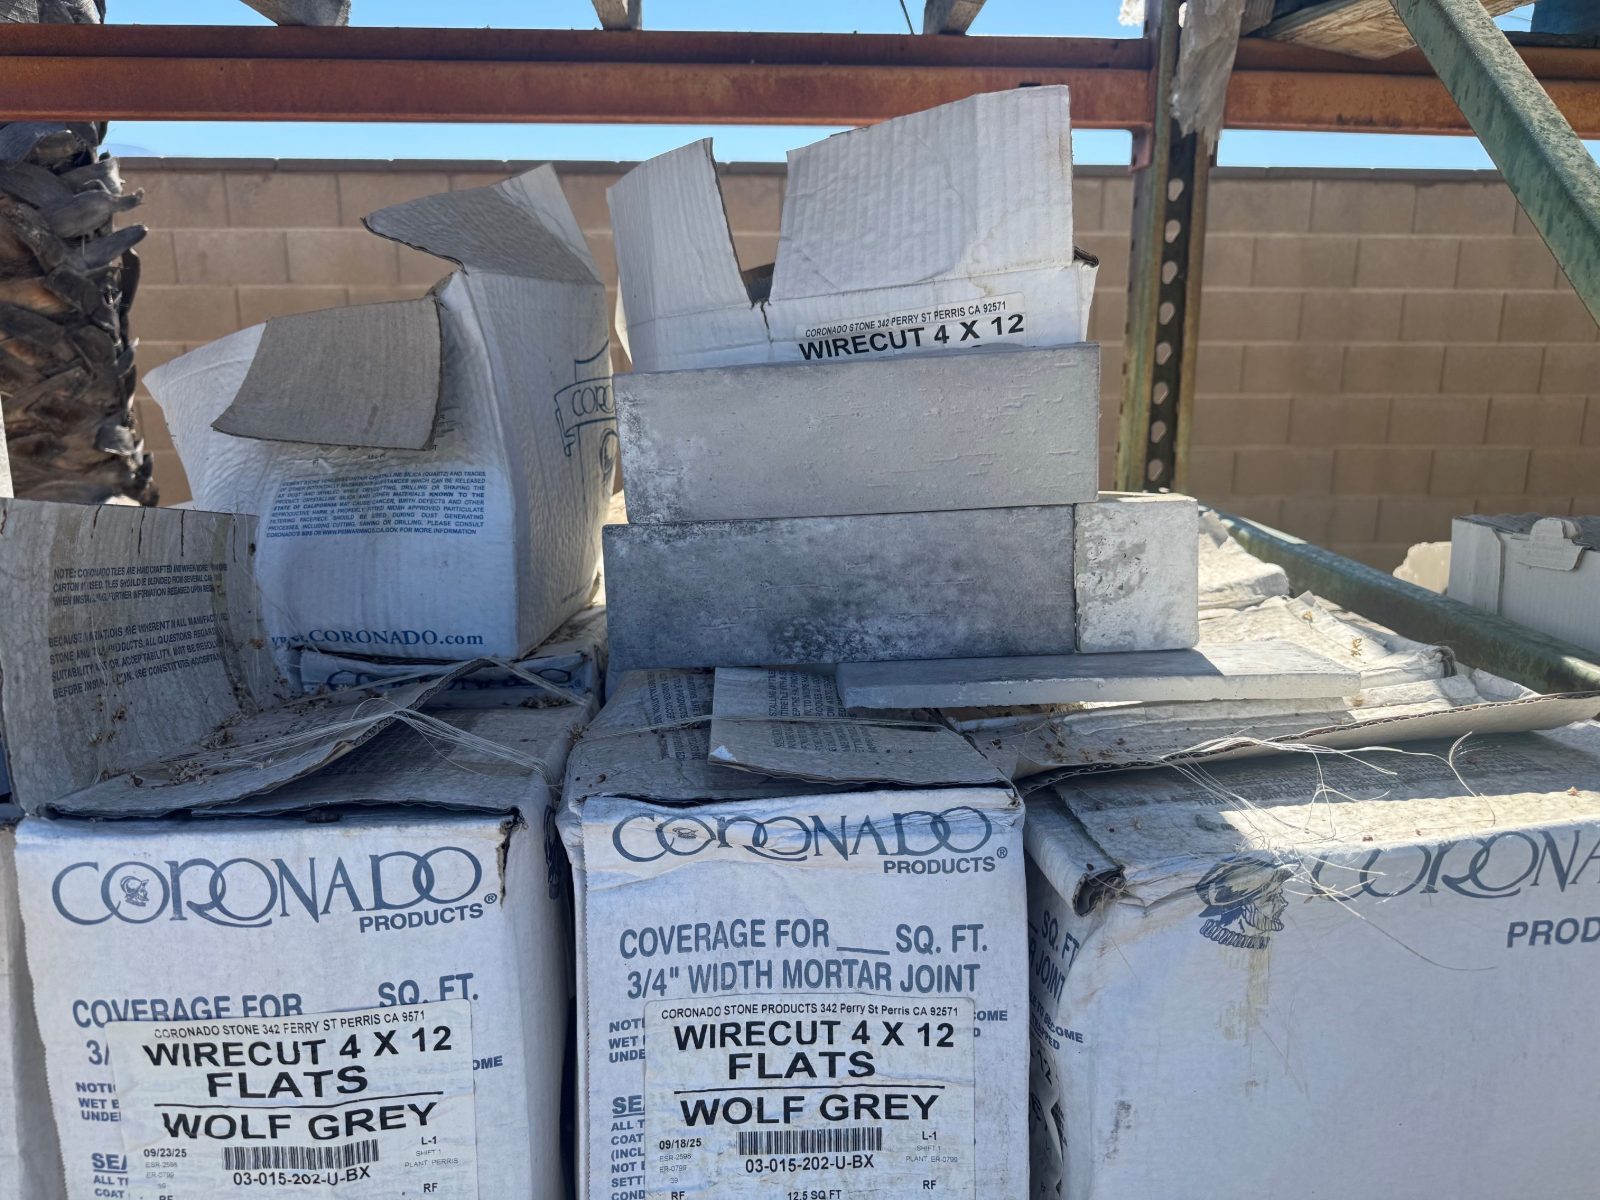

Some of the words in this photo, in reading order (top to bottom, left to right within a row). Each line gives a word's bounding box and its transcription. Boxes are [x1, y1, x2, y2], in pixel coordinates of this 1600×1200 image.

[805, 324, 848, 338] CORONADO
[849, 321, 876, 332] STONE
[877, 319, 890, 328] 342
[891, 314, 919, 327] PERRY
[921, 312, 932, 322] ST
[934, 307, 966, 320] PERRIS
[968, 305, 981, 315] CA
[983, 301, 1006, 313] 92571
[798, 327, 925, 360] WIRECUT
[933, 324, 950, 344] 4
[960, 320, 981, 341] X
[990, 313, 1024, 336] 12
[611, 805, 993, 862] CORONADO
[52, 846, 483, 928] CORONADO
[619, 919, 766, 960] COVERAGE
[775, 918, 829, 948] FOR
[895, 923, 942, 954] SQ.
[952, 923, 988, 953] FT.
[627, 966, 680, 999] 3/4"
[688, 959, 773, 994] WIDTH
[782, 959, 892, 991] MORTAR
[900, 963, 981, 993] JOINT
[72, 995, 231, 1029] COVERAGE
[242, 993, 303, 1018] FOR
[439, 972, 479, 1001] FT.
[662, 1006, 722, 1020] CORONADO
[724, 1004, 758, 1015] STONE
[761, 1003, 817, 1014] PRODUCTS
[820, 1004, 837, 1013] 342
[840, 1004, 866, 1016] Perry
[868, 1005, 879, 1014] St
[881, 1006, 910, 1016] Perris
[913, 1007, 927, 1016] CA
[930, 1007, 958, 1016] 92571
[154, 1025, 220, 1038] CORONADO
[223, 1024, 259, 1036] STONE
[262, 1024, 280, 1035] 342
[323, 1018, 337, 1031] ST
[340, 1013, 381, 1029] PERRIS
[384, 1012, 399, 1023] CA
[402, 1010, 425, 1022] 9571
[674, 1020, 840, 1050] WIRECUT
[851, 1020, 871, 1045] 4
[881, 1021, 904, 1046] X
[917, 1023, 954, 1047] 12
[142, 1039, 326, 1067] WIRECUT
[339, 1034, 361, 1059] 4
[373, 1030, 399, 1056] X
[412, 1026, 452, 1052] 12
[608, 1036, 638, 1049] WET
[729, 1051, 875, 1080] FLATS
[207, 1065, 368, 1098] FLATS
[78, 1098, 107, 1109] WET
[680, 1096, 805, 1127] WOLF
[819, 1094, 939, 1121] GREY
[162, 1113, 291, 1139] WOLF
[308, 1102, 437, 1140] GREY
[611, 1121, 634, 1132] ALL
[421, 1136, 437, 1145] L-1
[611, 1134, 645, 1145] COAT
[922, 1131, 937, 1141] L-1
[659, 1138, 702, 1150] 09/18/25
[143, 1148, 187, 1157] 09/23/25
[415, 1149, 436, 1157] SHIFT
[404, 1160, 429, 1168] PLANT
[611, 1162, 637, 1173] NOT
[745, 1154, 874, 1173] 03-015-202-U-BX
[93, 1175, 115, 1185] ALL
[233, 1165, 371, 1186] 03-015-202-U-BX
[423, 1183, 438, 1193] RF
[923, 1180, 937, 1190] RF
[94, 1188, 125, 1199] COAT
[611, 1190, 645, 1200] COND
[671, 1191, 686, 1200] RF
[811, 1191, 826, 1200] SQ
[829, 1190, 842, 1200] FT
